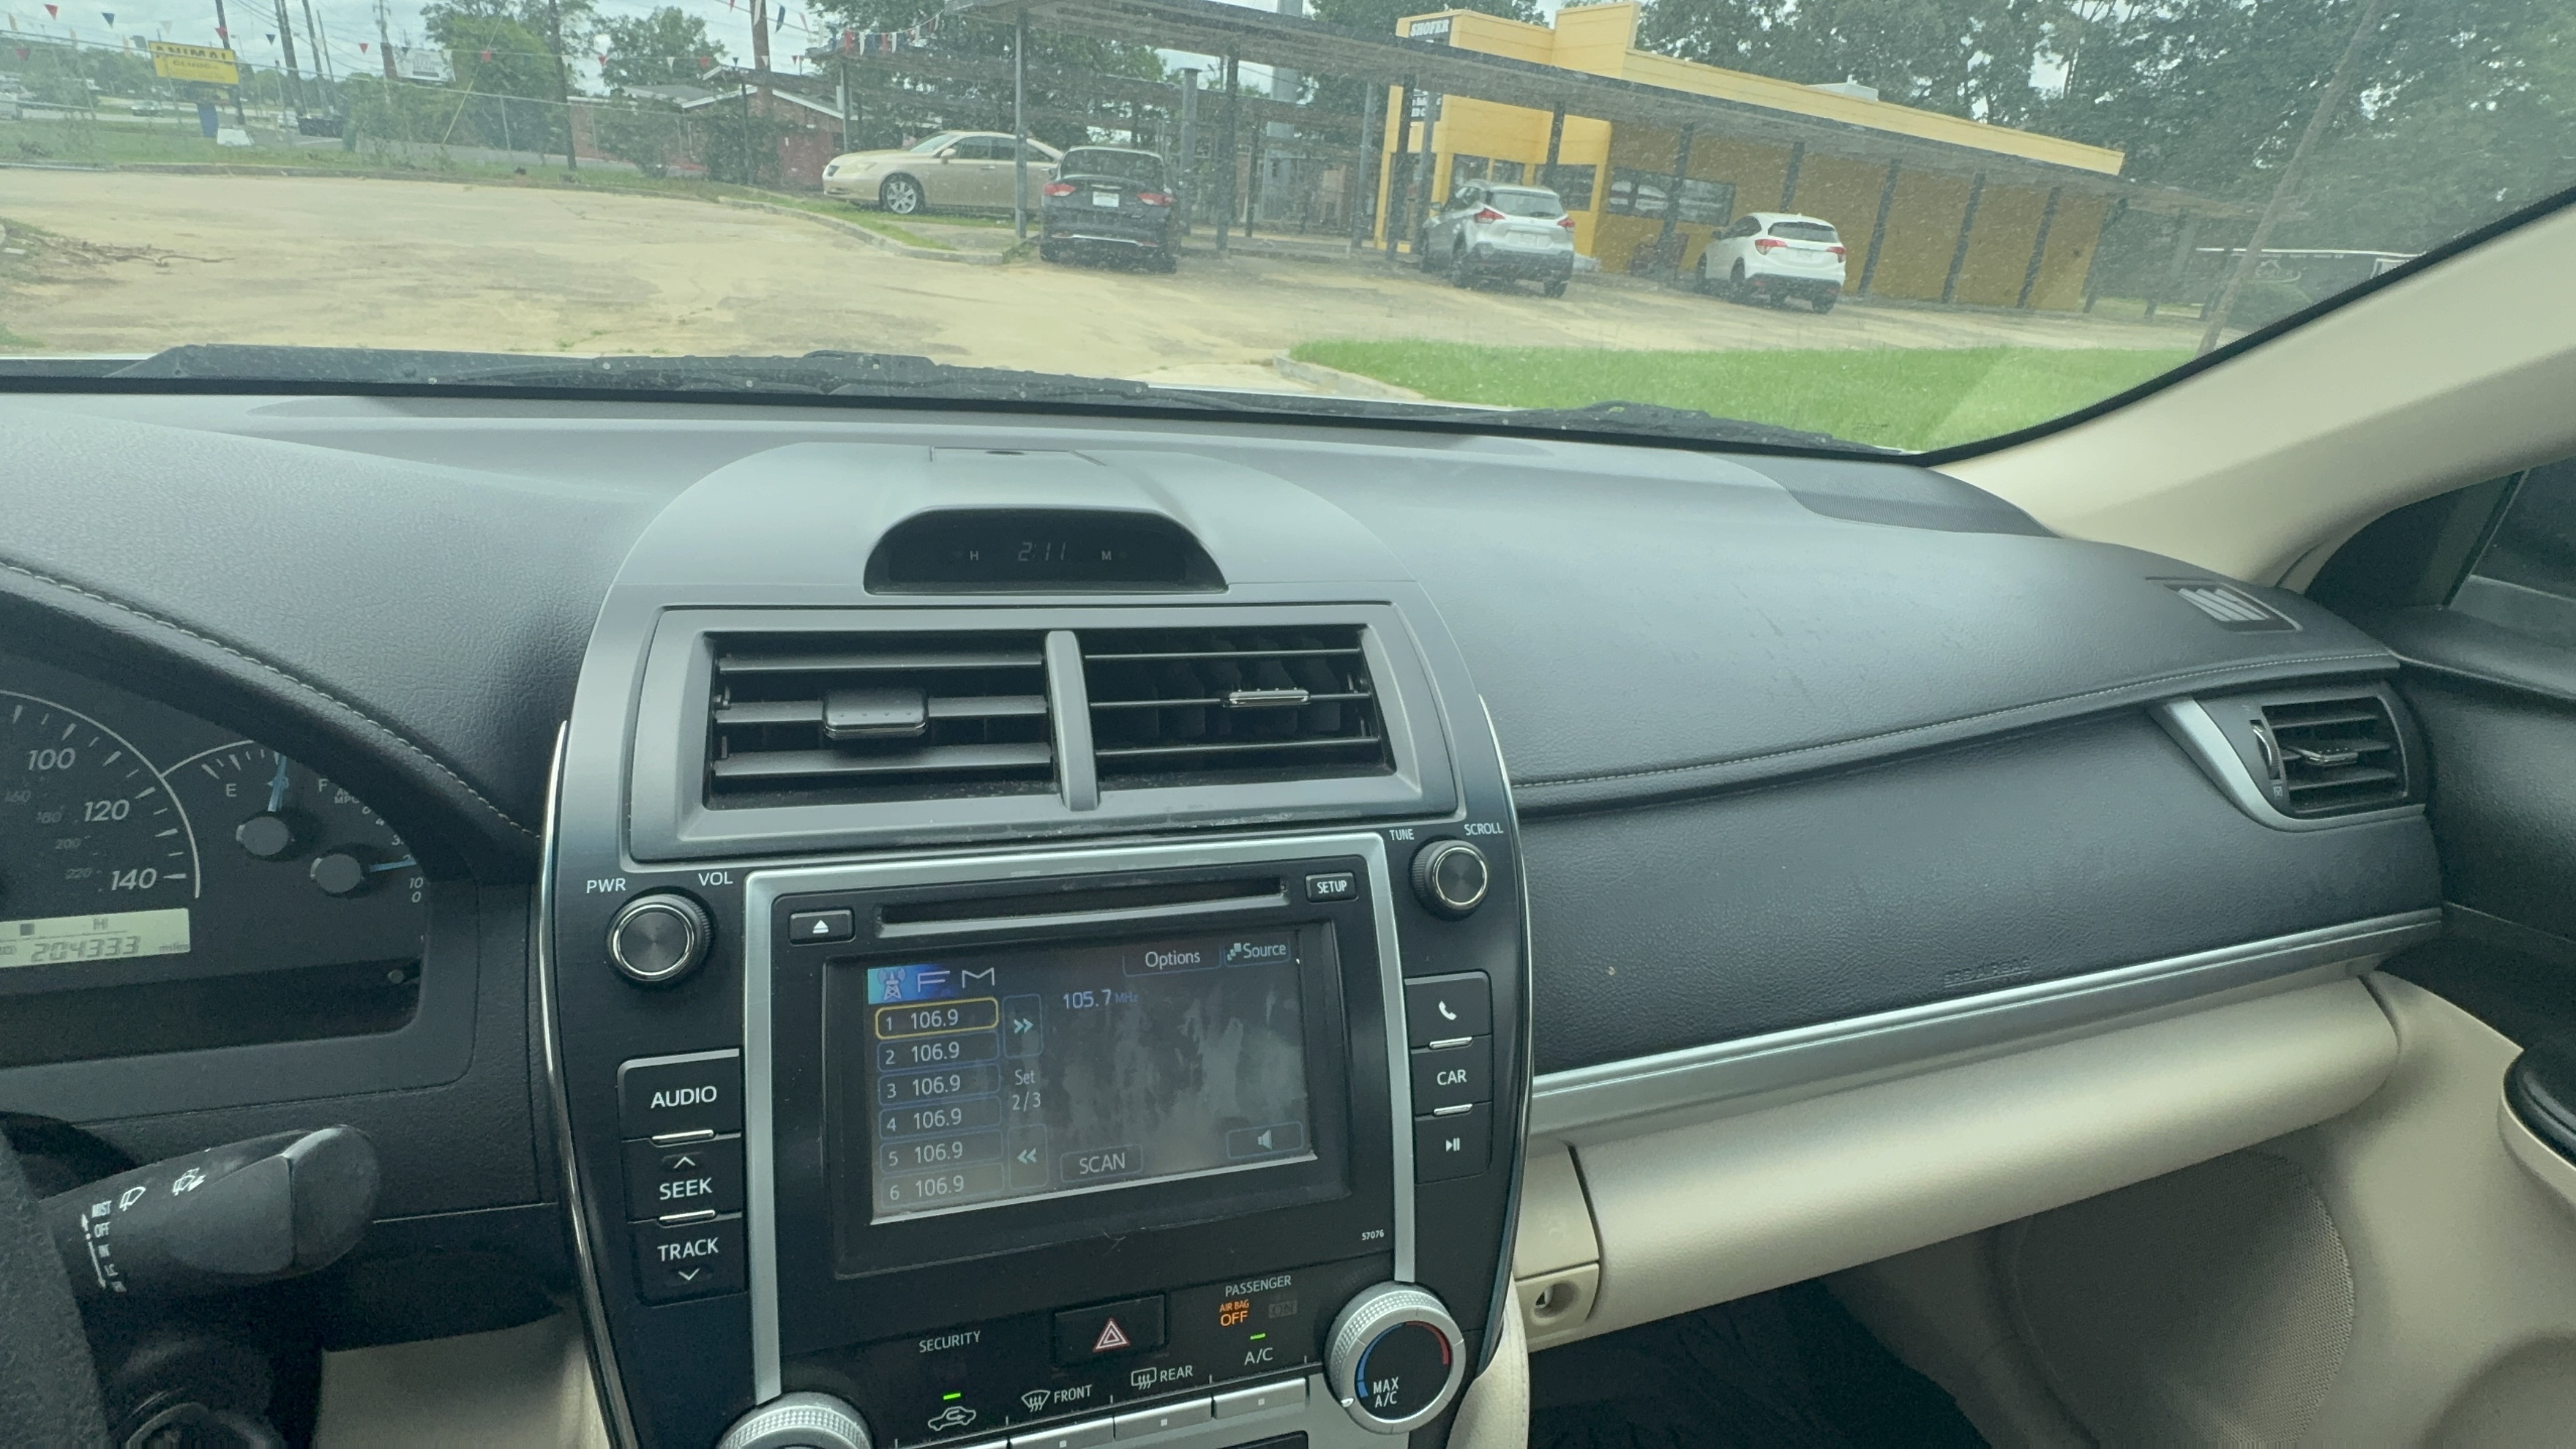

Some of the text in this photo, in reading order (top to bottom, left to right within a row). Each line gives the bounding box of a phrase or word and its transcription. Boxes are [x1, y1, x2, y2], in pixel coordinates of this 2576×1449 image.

[970, 550, 978, 561] H
[1018, 542, 1067, 561] 2:11
[1101, 550, 1112, 561] M
[29, 747, 75, 771] 100
[225, 783, 236, 797] E
[318, 779, 327, 793] F
[84, 799, 130, 822] 120
[1389, 828, 1415, 842] TUNE
[1464, 823, 1503, 836] SCROLL
[111, 867, 157, 891] 140
[410, 877, 423, 889] 10
[586, 877, 626, 894] PWR
[698, 872, 733, 886] VOL
[1317, 880, 1347, 894] SETUP
[411, 891, 422, 903] 0
[31, 935, 141, 962] 204333
[1243, 943, 1287, 959] Source
[1145, 951, 1201, 970] Options
[1063, 989, 1138, 1010] 105.7 MHz
[886, 1008, 959, 1030] 1 106.9
[886, 1041, 959, 1065] 2 106.9
[886, 1074, 961, 1098] 3 106.9
[1014, 1068, 1035, 1086] Set
[1437, 1069, 1467, 1085] CAR
[651, 1086, 717, 1109] AUDIO
[1012, 1092, 1041, 1112] 2/3
[886, 1108, 962, 1132] 4 106.9
[888, 1142, 963, 1167] 5 106.9
[1079, 1153, 1126, 1175] SCAN
[659, 1177, 713, 1200] SEEK
[890, 1175, 964, 1200] 6 106.9
[94, 1221, 111, 1238] OFF
[1362, 1229, 1385, 1240] 57076
[657, 1237, 719, 1262] TRACK
[1225, 1275, 1292, 1297] PASSENGER
[1219, 1300, 1249, 1313] AIR BAG
[1270, 1300, 1296, 1317] ON
[1220, 1311, 1248, 1327] OFF
[919, 1330, 981, 1353] SECURITY
[1244, 1347, 1273, 1366] A/C
[1160, 1365, 1194, 1382] REAR
[1374, 1376, 1399, 1394] MAX
[1053, 1385, 1093, 1404] FRONT
[1375, 1390, 1397, 1408] A/C
